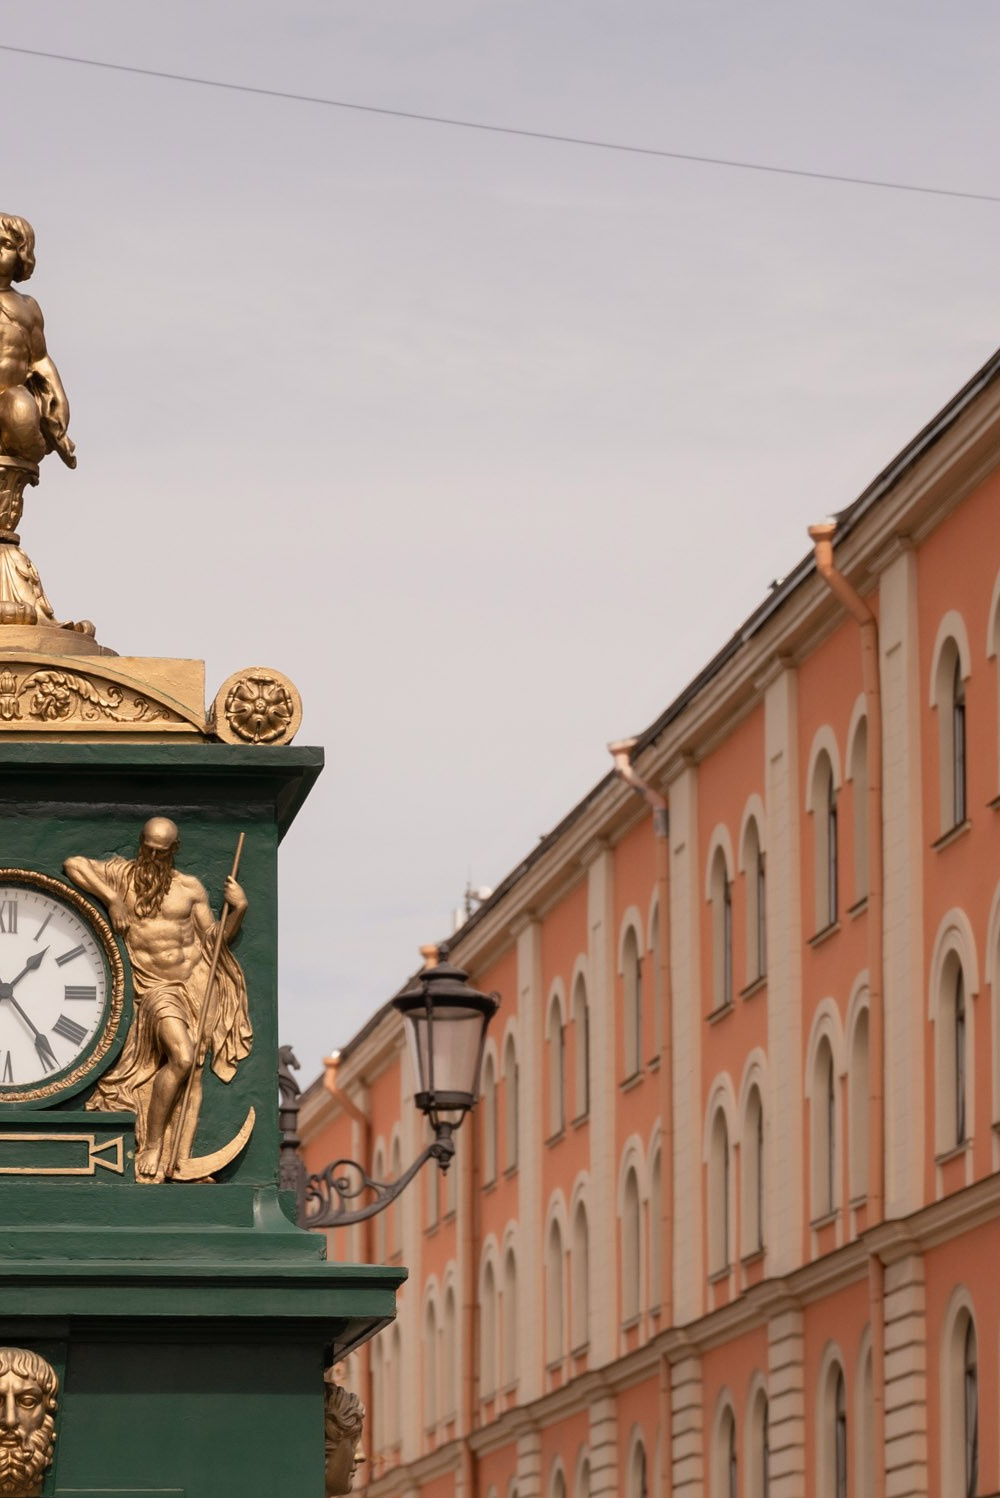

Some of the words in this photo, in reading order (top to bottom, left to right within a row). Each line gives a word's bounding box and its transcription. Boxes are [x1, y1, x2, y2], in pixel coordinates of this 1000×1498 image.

[34, 912, 53, 941] I
[56, 944, 86, 966] II
[65, 985, 96, 1000] III
[52, 1015, 89, 1045] IIII
